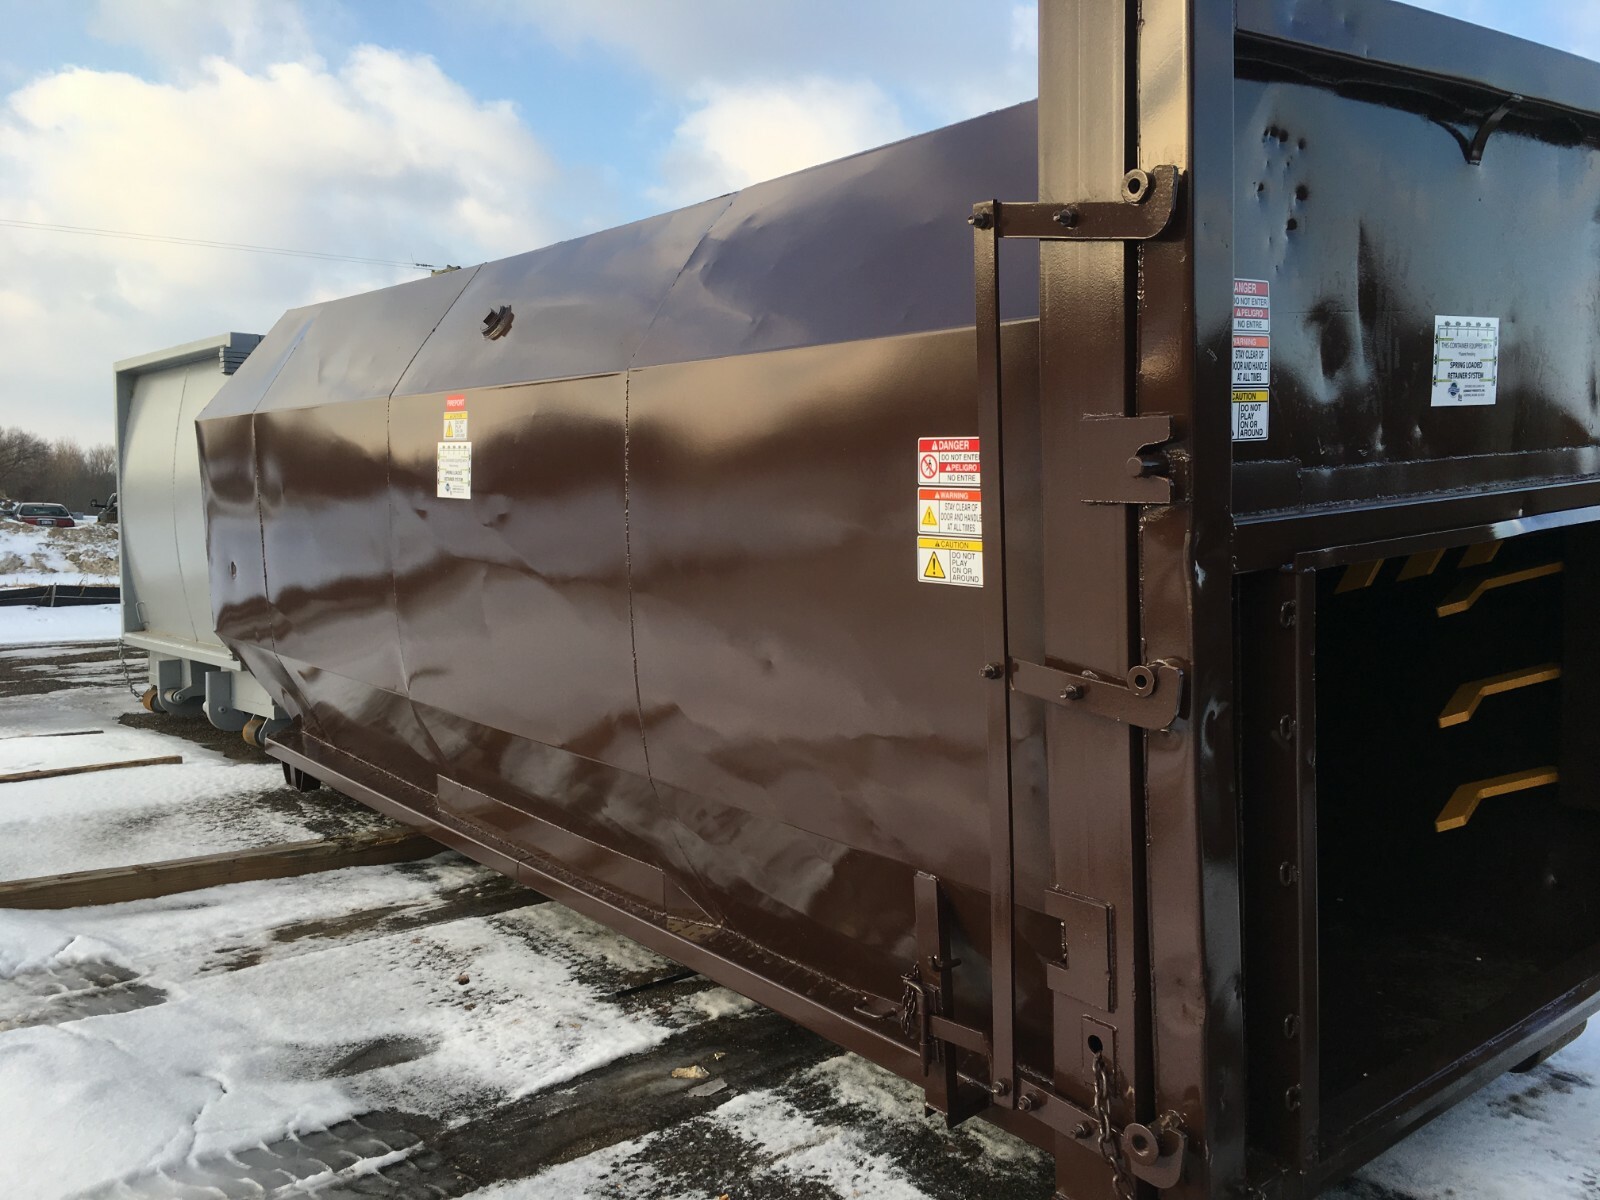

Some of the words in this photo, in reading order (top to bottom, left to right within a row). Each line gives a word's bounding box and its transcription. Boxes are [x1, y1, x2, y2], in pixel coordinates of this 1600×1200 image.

[1234, 282, 1256, 294] ANGER
[1240, 298, 1250, 306] NOT
[1252, 298, 1267, 306] ENTER
[1242, 308, 1264, 317] PELIGRO
[1246, 320, 1262, 328] ENTRE
[1235, 350, 1244, 359] STAY
[1245, 350, 1259, 359] CLEAR
[1259, 350, 1264, 359] OF
[1244, 362, 1252, 370] AND
[1253, 362, 1267, 370] HANDLE
[1237, 373, 1242, 381] AT
[1251, 373, 1262, 381] TIMES
[939, 440, 969, 450] DANGER
[956, 503, 970, 511] CLEAR
[965, 514, 982, 522] HANDLE
[962, 524, 975, 532] TIMES
